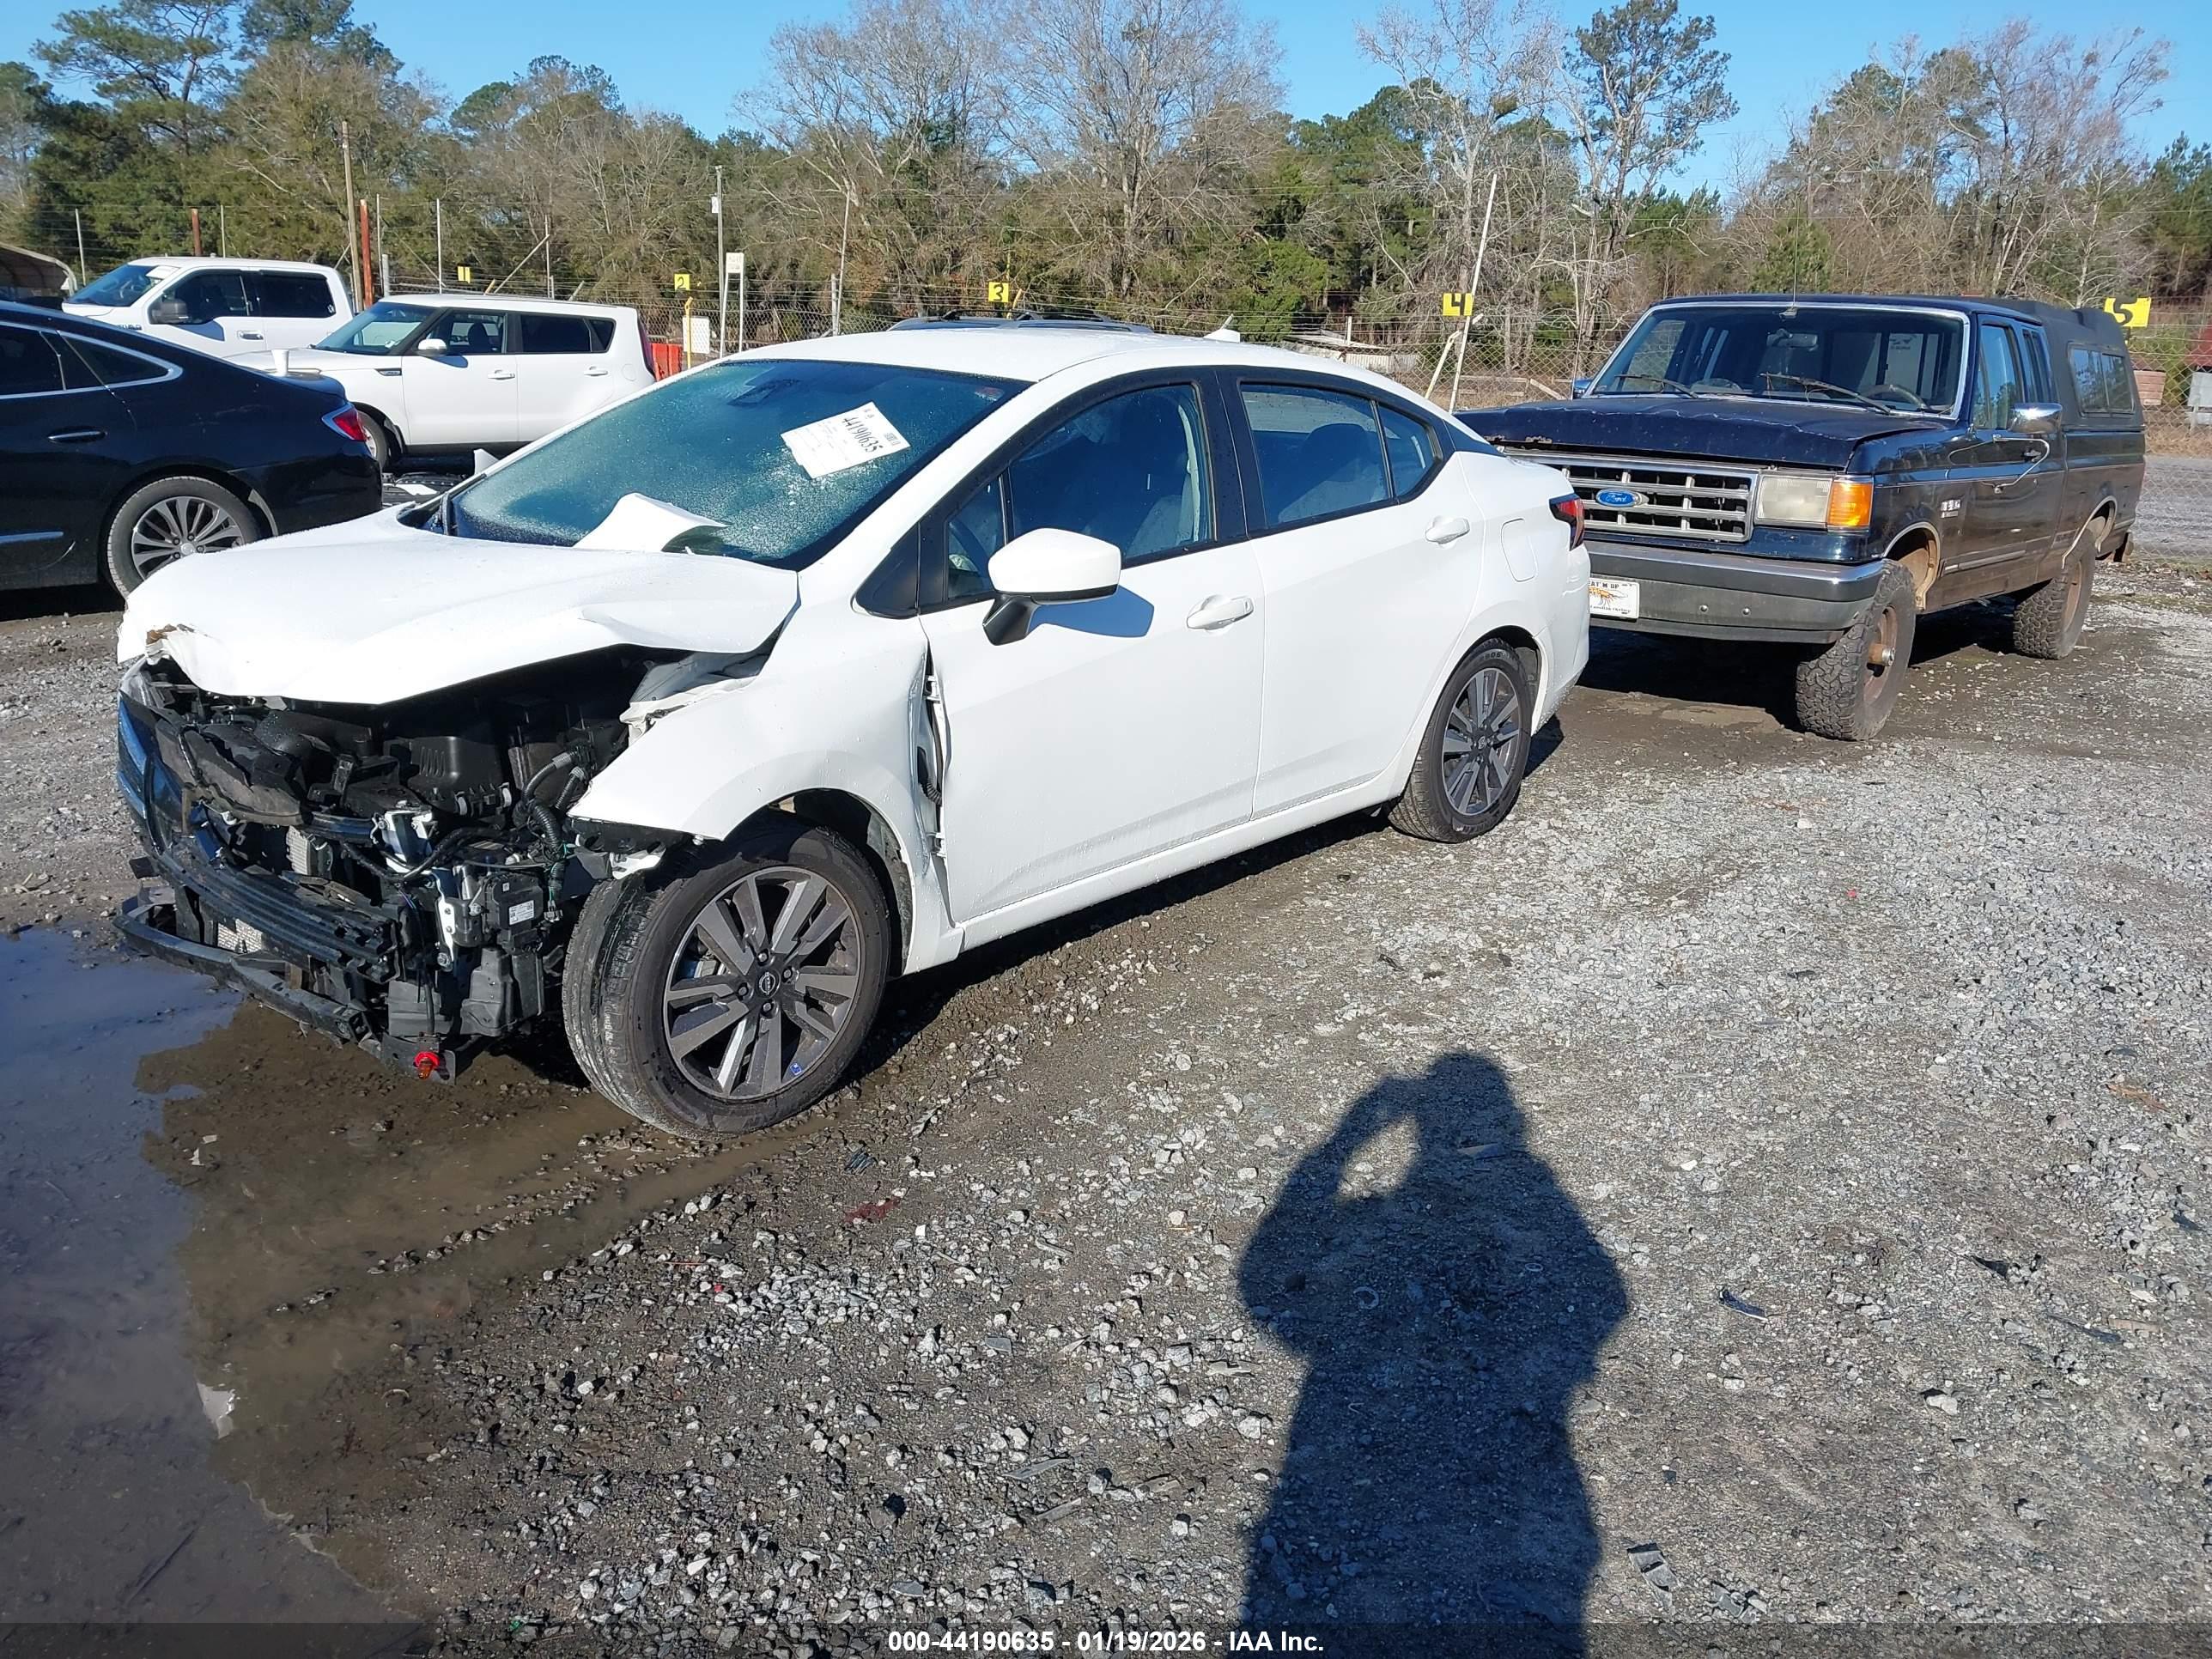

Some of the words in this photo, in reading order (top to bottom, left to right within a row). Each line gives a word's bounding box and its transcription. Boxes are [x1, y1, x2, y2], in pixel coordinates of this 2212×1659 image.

[677, 276, 687, 289] 2
[993, 284, 1005, 301] 3
[1451, 293, 1466, 316] 4
[2113, 295, 2136, 325] 5
[840, 416, 884, 453] 44190635
